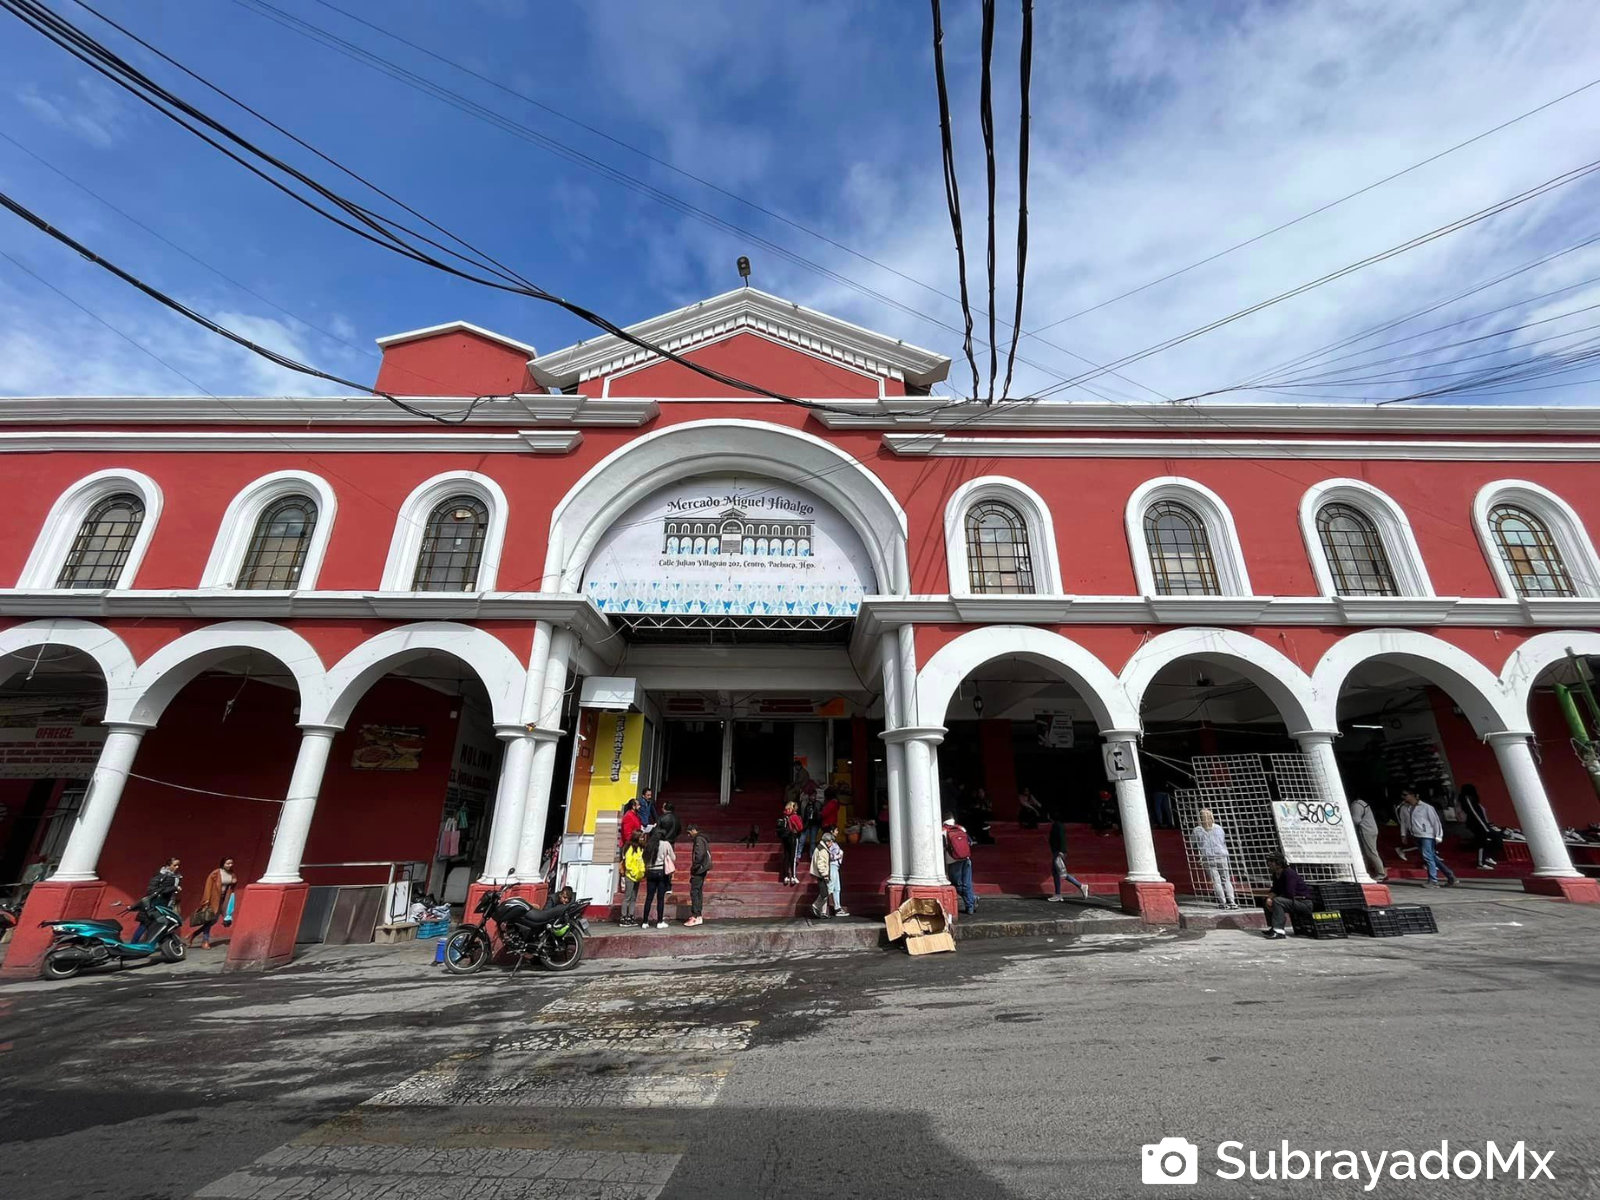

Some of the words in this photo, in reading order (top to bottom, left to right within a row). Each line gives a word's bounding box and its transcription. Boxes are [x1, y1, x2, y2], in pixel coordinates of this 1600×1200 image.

[667, 496, 720, 512] Mercado
[723, 494, 765, 508] Miguel
[767, 496, 814, 515] Hidalgo
[658, 559, 675, 567] Calle
[743, 561, 766, 569] Centro,
[768, 561, 798, 570] Pachuca,
